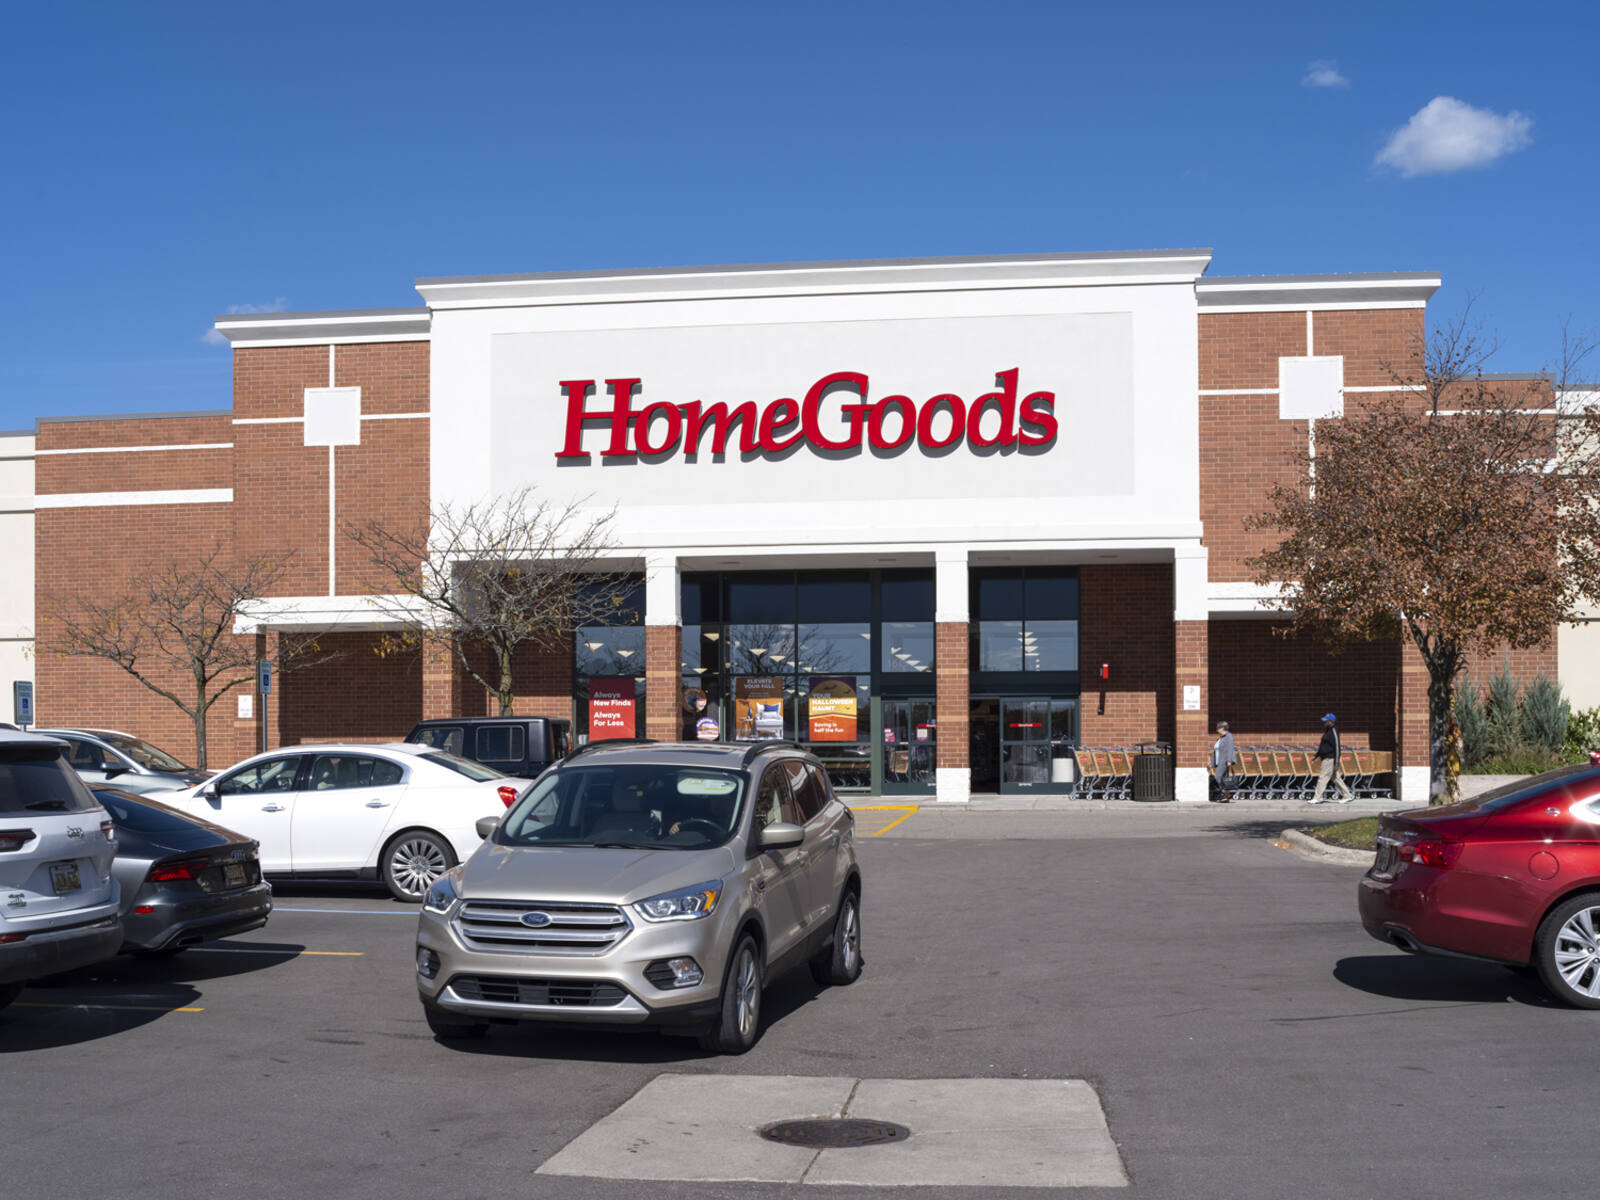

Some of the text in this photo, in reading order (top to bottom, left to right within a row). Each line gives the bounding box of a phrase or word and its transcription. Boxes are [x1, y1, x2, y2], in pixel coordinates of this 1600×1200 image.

[555, 367, 1059, 460] HomeGoods
[593, 691, 621, 700] Always
[593, 711, 621, 720] Always
